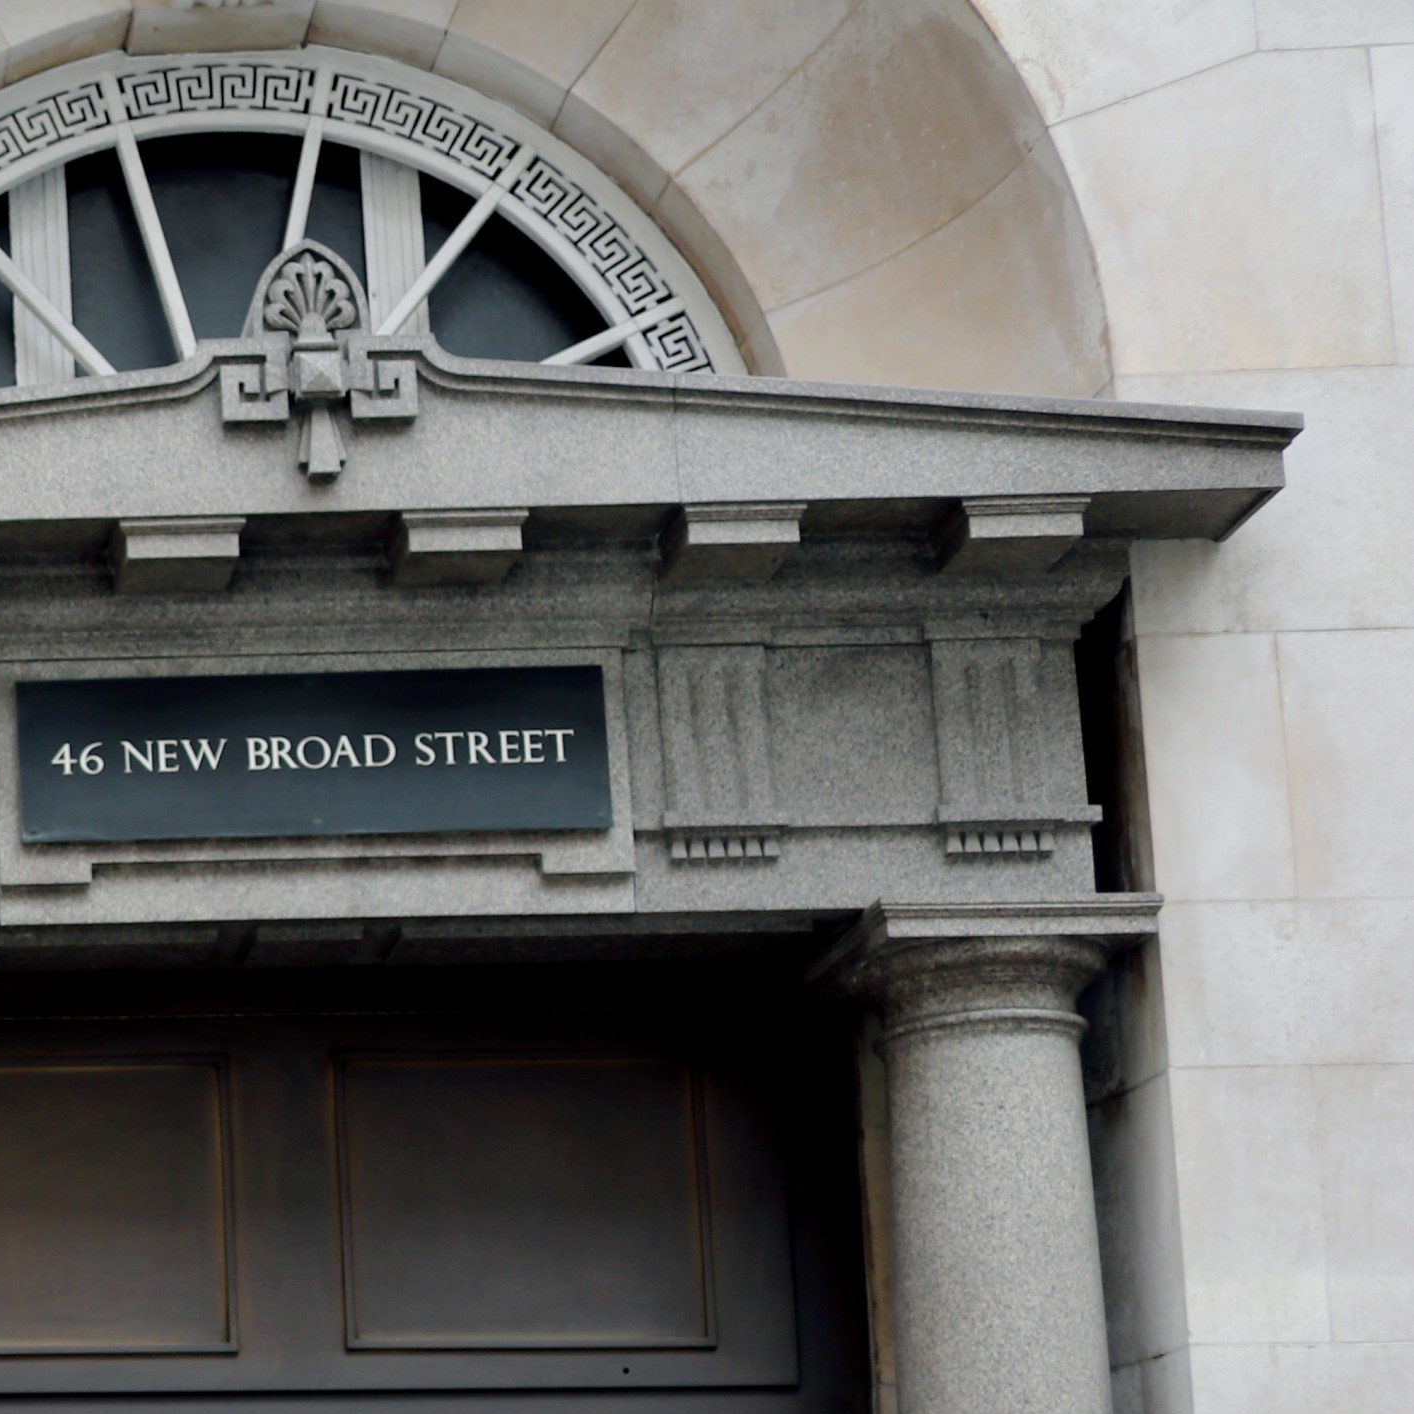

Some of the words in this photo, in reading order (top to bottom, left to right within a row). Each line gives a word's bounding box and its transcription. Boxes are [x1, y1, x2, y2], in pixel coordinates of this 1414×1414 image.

[51, 741, 105, 776] 46
[120, 737, 228, 774] NEW
[245, 733, 397, 771] BROAD
[413, 728, 575, 766] STREET
